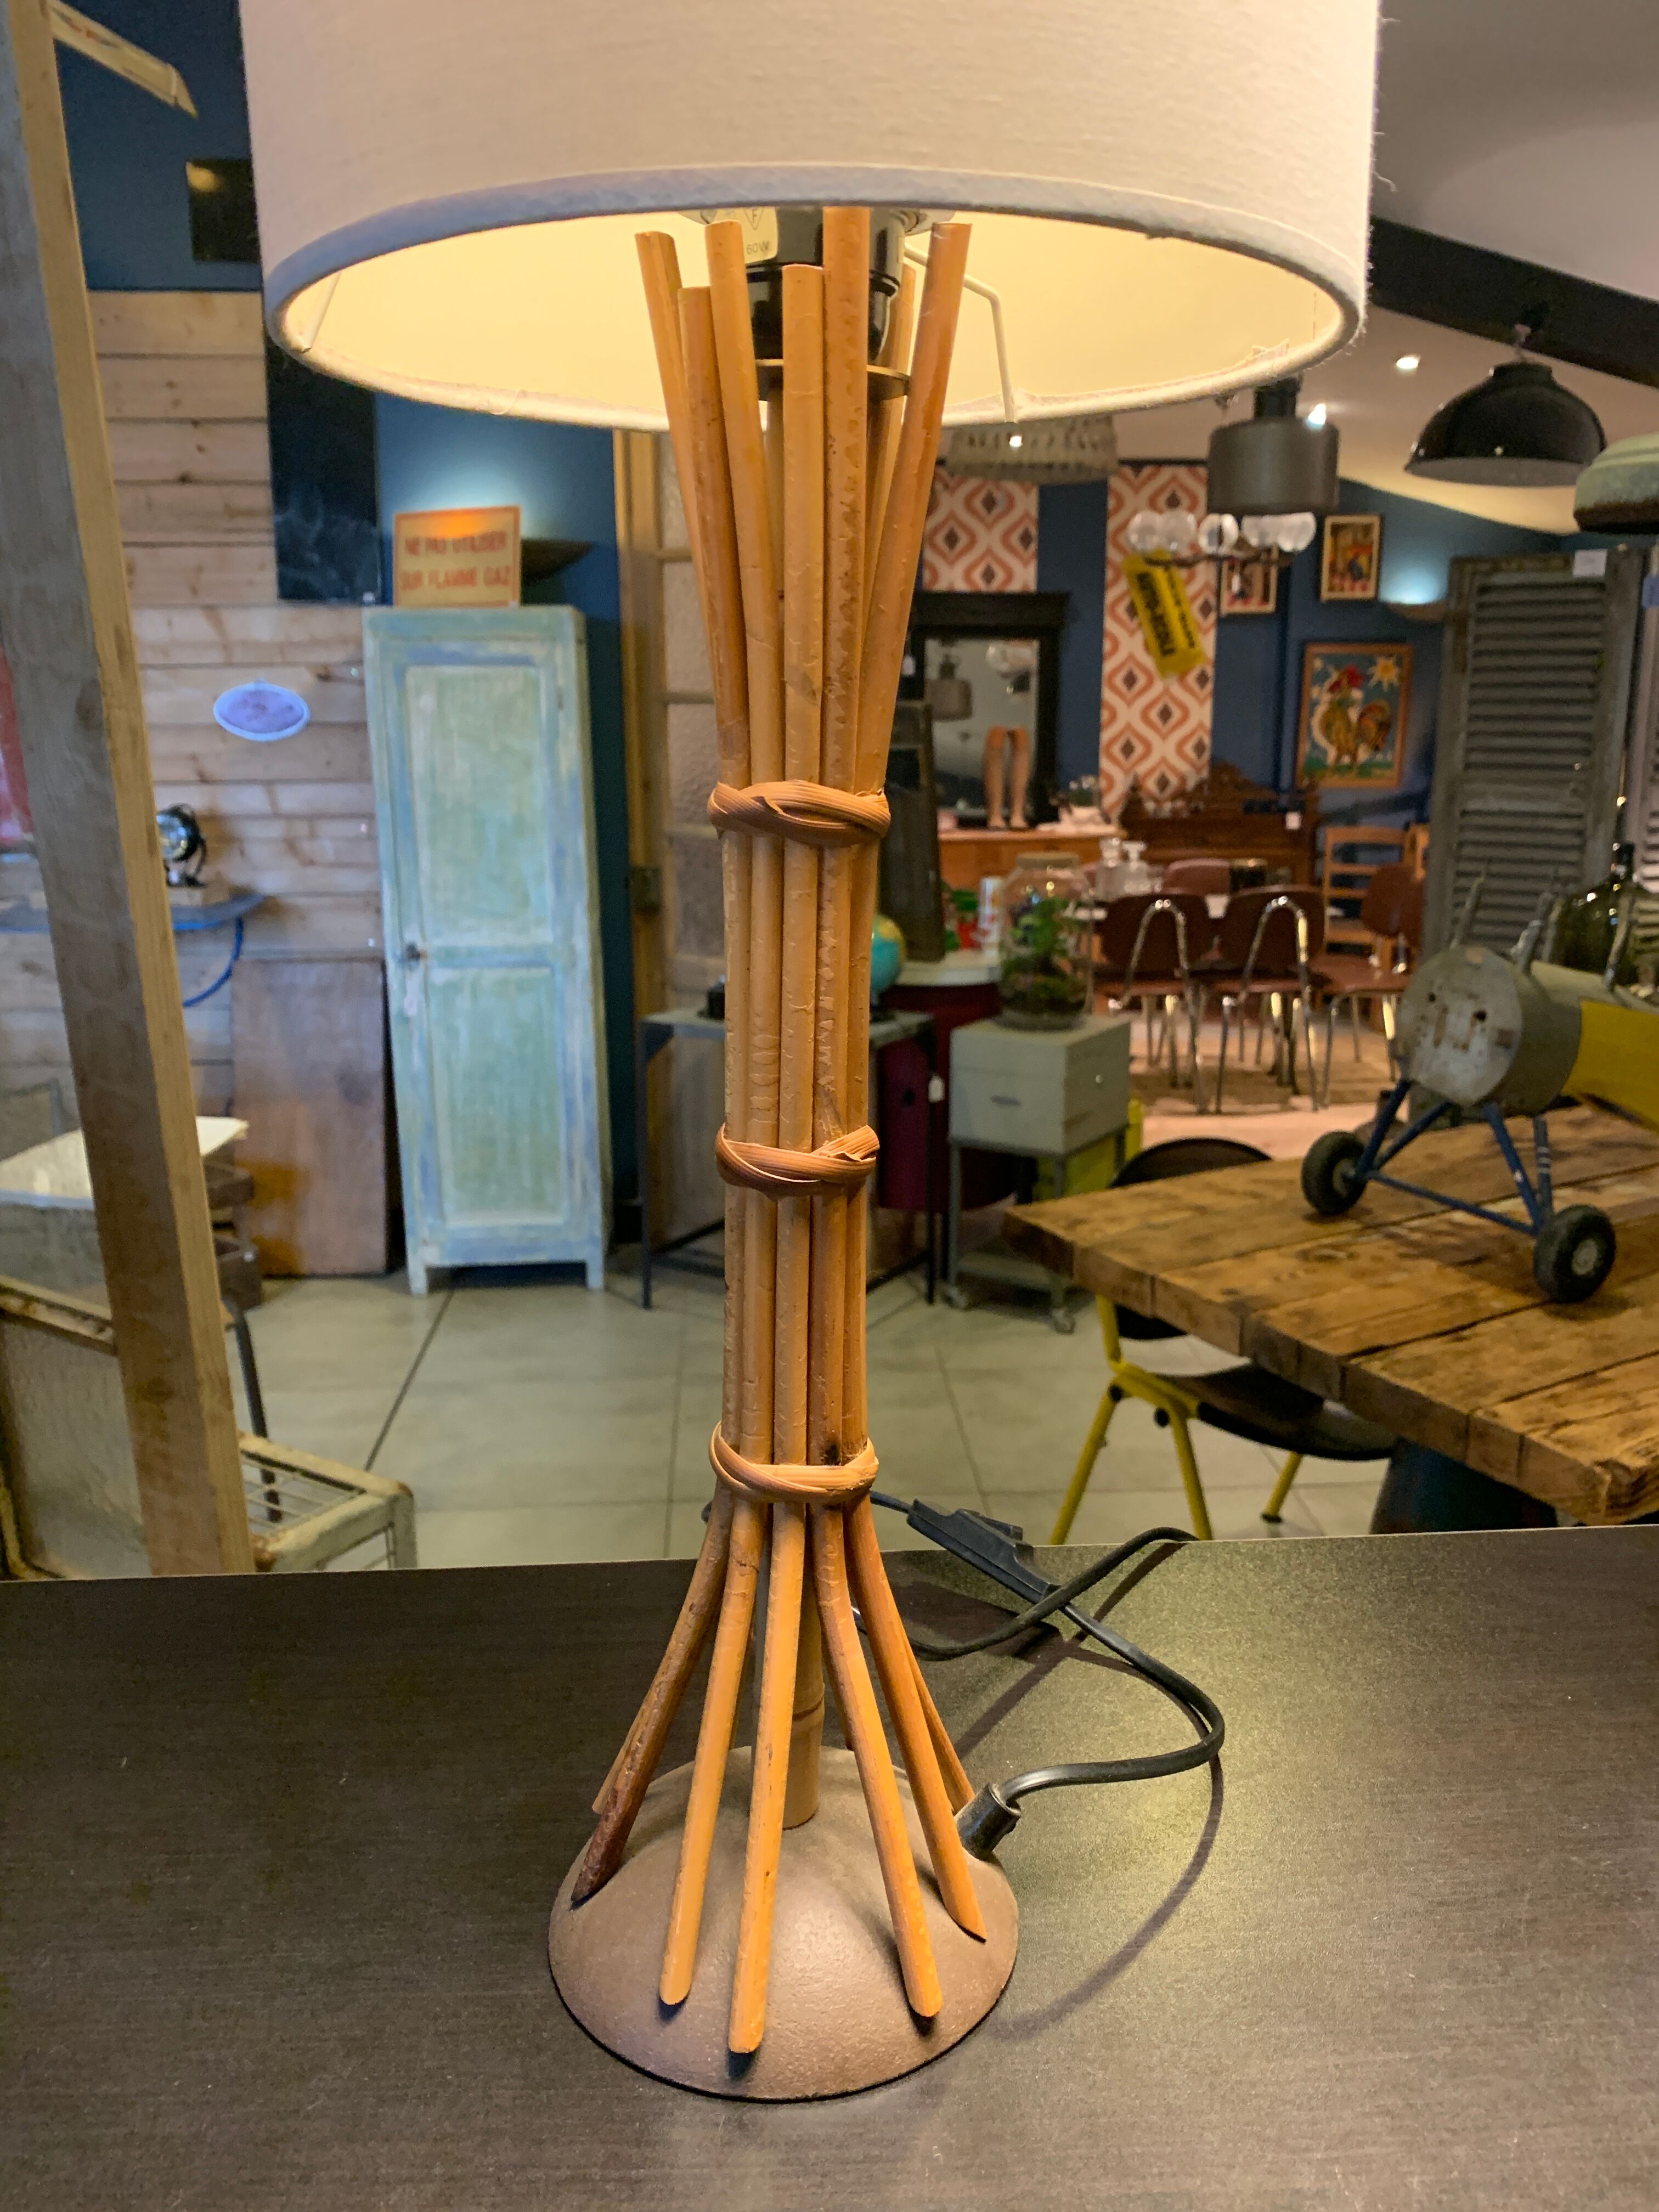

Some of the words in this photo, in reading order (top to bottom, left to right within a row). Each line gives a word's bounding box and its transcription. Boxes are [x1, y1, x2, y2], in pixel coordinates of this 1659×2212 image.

[746, 240, 770, 255] 60W
[404, 537, 420, 557] NE
[400, 569, 424, 590] SUR
[427, 567, 478, 590] FLAMME
[483, 566, 510, 587] GAZ
